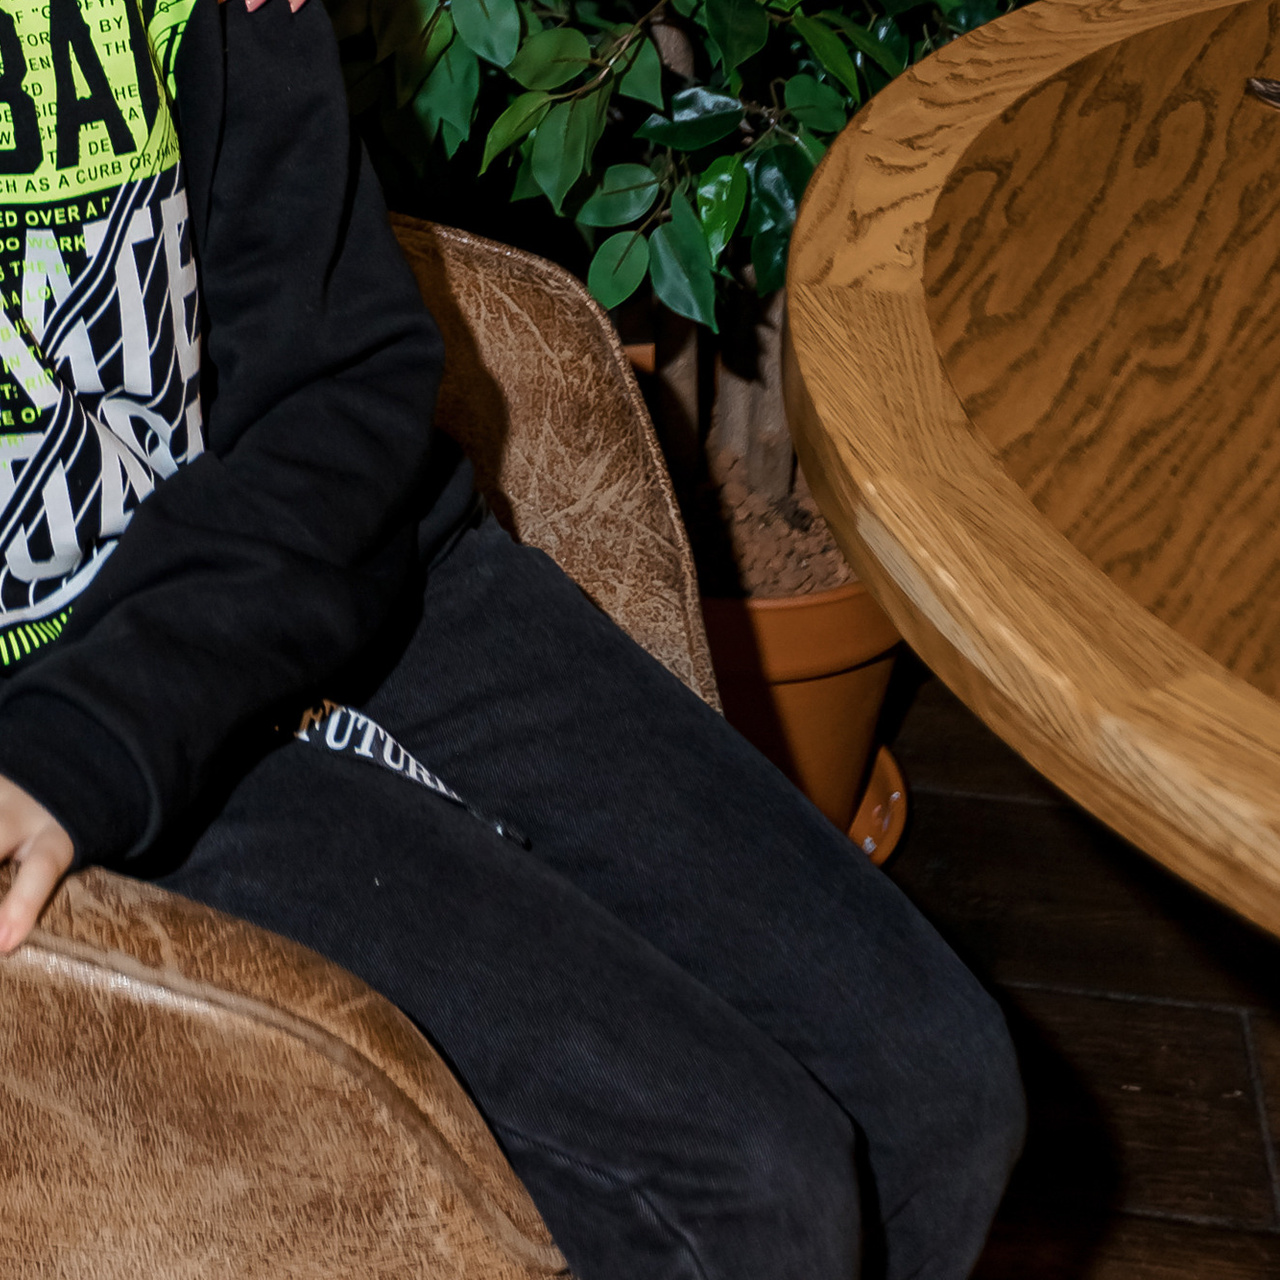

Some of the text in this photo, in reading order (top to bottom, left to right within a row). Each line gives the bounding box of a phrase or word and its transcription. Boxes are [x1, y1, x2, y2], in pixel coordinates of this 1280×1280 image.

[99, 16, 123, 33] BY
[24, 176, 51, 194] AS
[58, 173, 70, 190] A
[75, 160, 123, 185] CURB
[128, 152, 152, 171] OR
[24, 205, 81, 227] OVER
[85, 201, 99, 220] A
[27, 234, 86, 253] WORK
